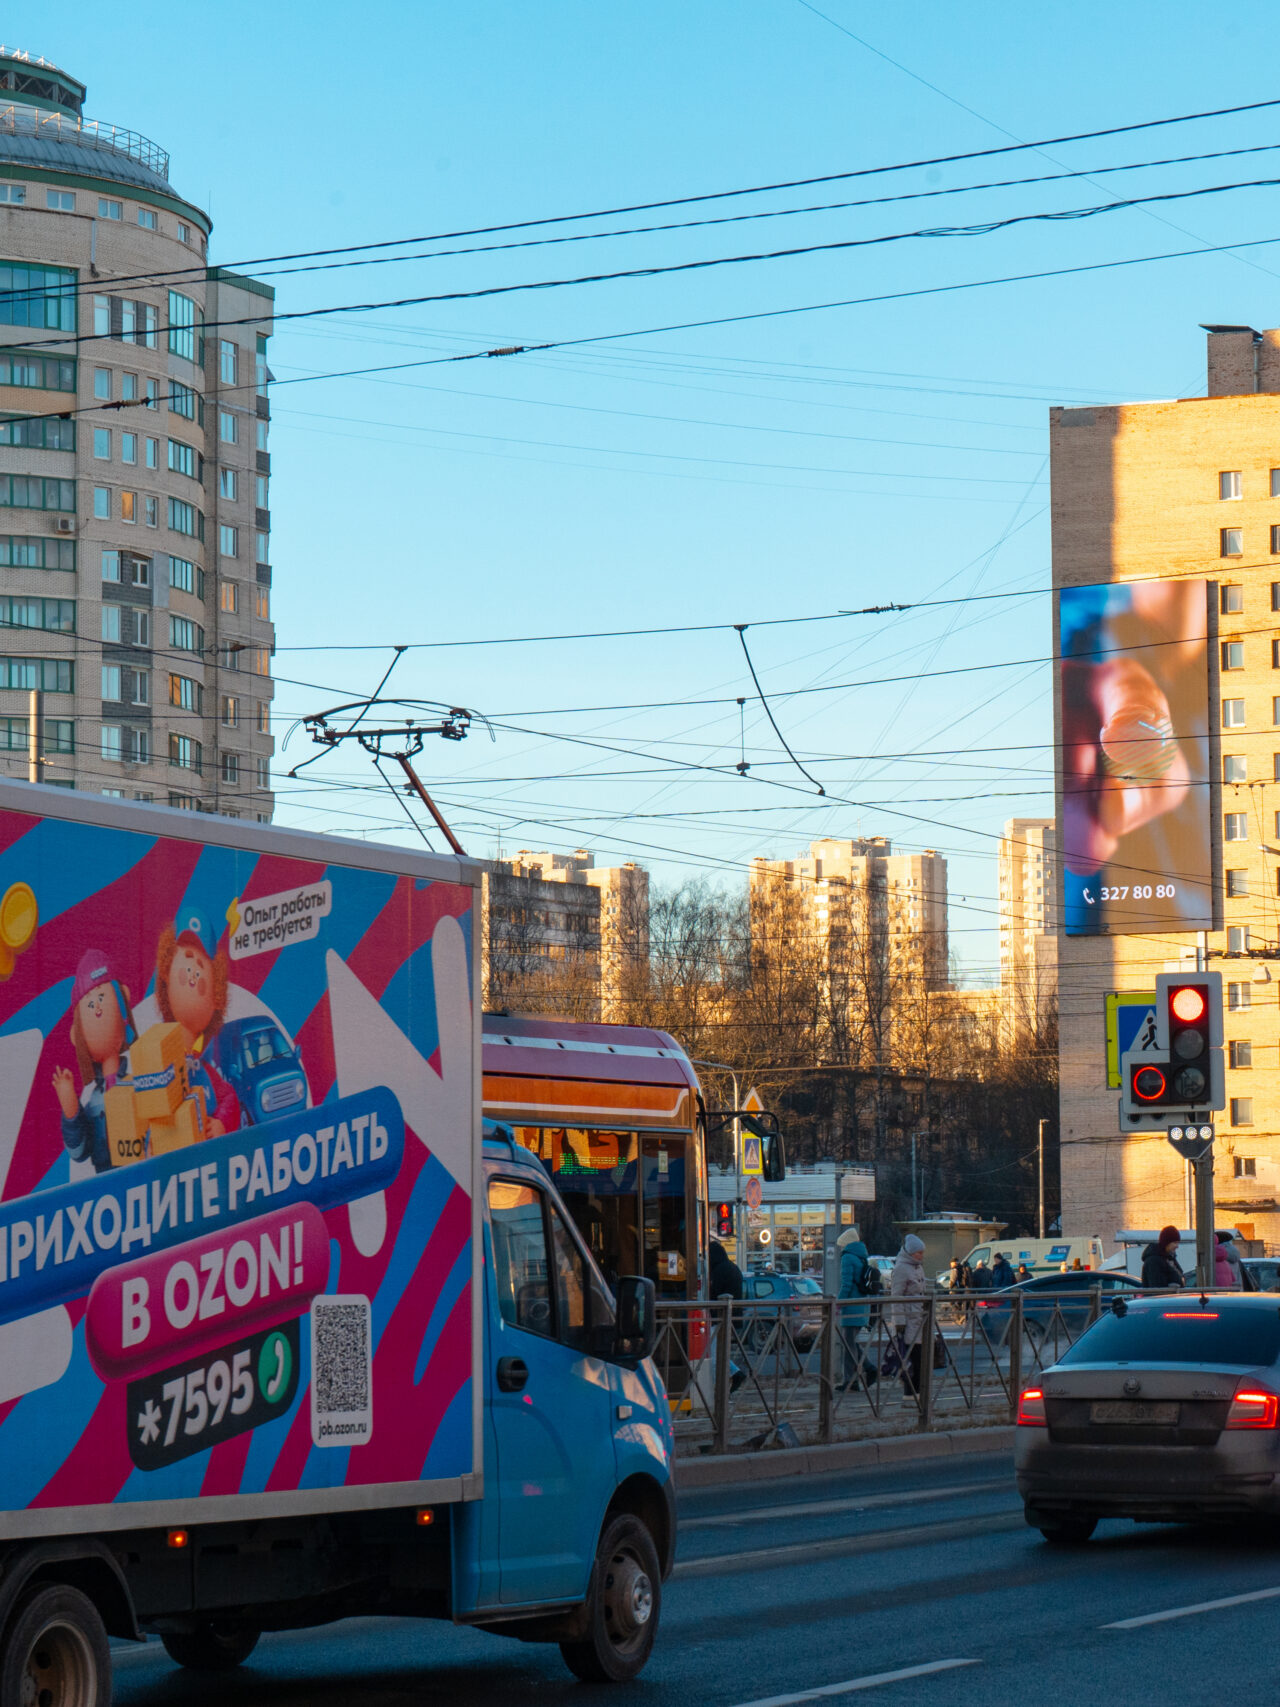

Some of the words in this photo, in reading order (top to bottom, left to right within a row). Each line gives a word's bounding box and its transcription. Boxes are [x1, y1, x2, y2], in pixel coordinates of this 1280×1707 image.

[244, 905, 278, 927] Опыт
[281, 891, 326, 922] работы
[1100, 886, 1130, 900] 327
[1133, 885, 1152, 899] 80
[1156, 884, 1175, 898] 80
[235, 933, 250, 950] не
[253, 914, 312, 949] требуется
[228, 1111, 389, 1213] РАБОТАТЬ
[121, 1277, 150, 1349] В
[163, 1220, 304, 1330] OZON!
[318, 1420, 368, 1440] job.ozon.ru
